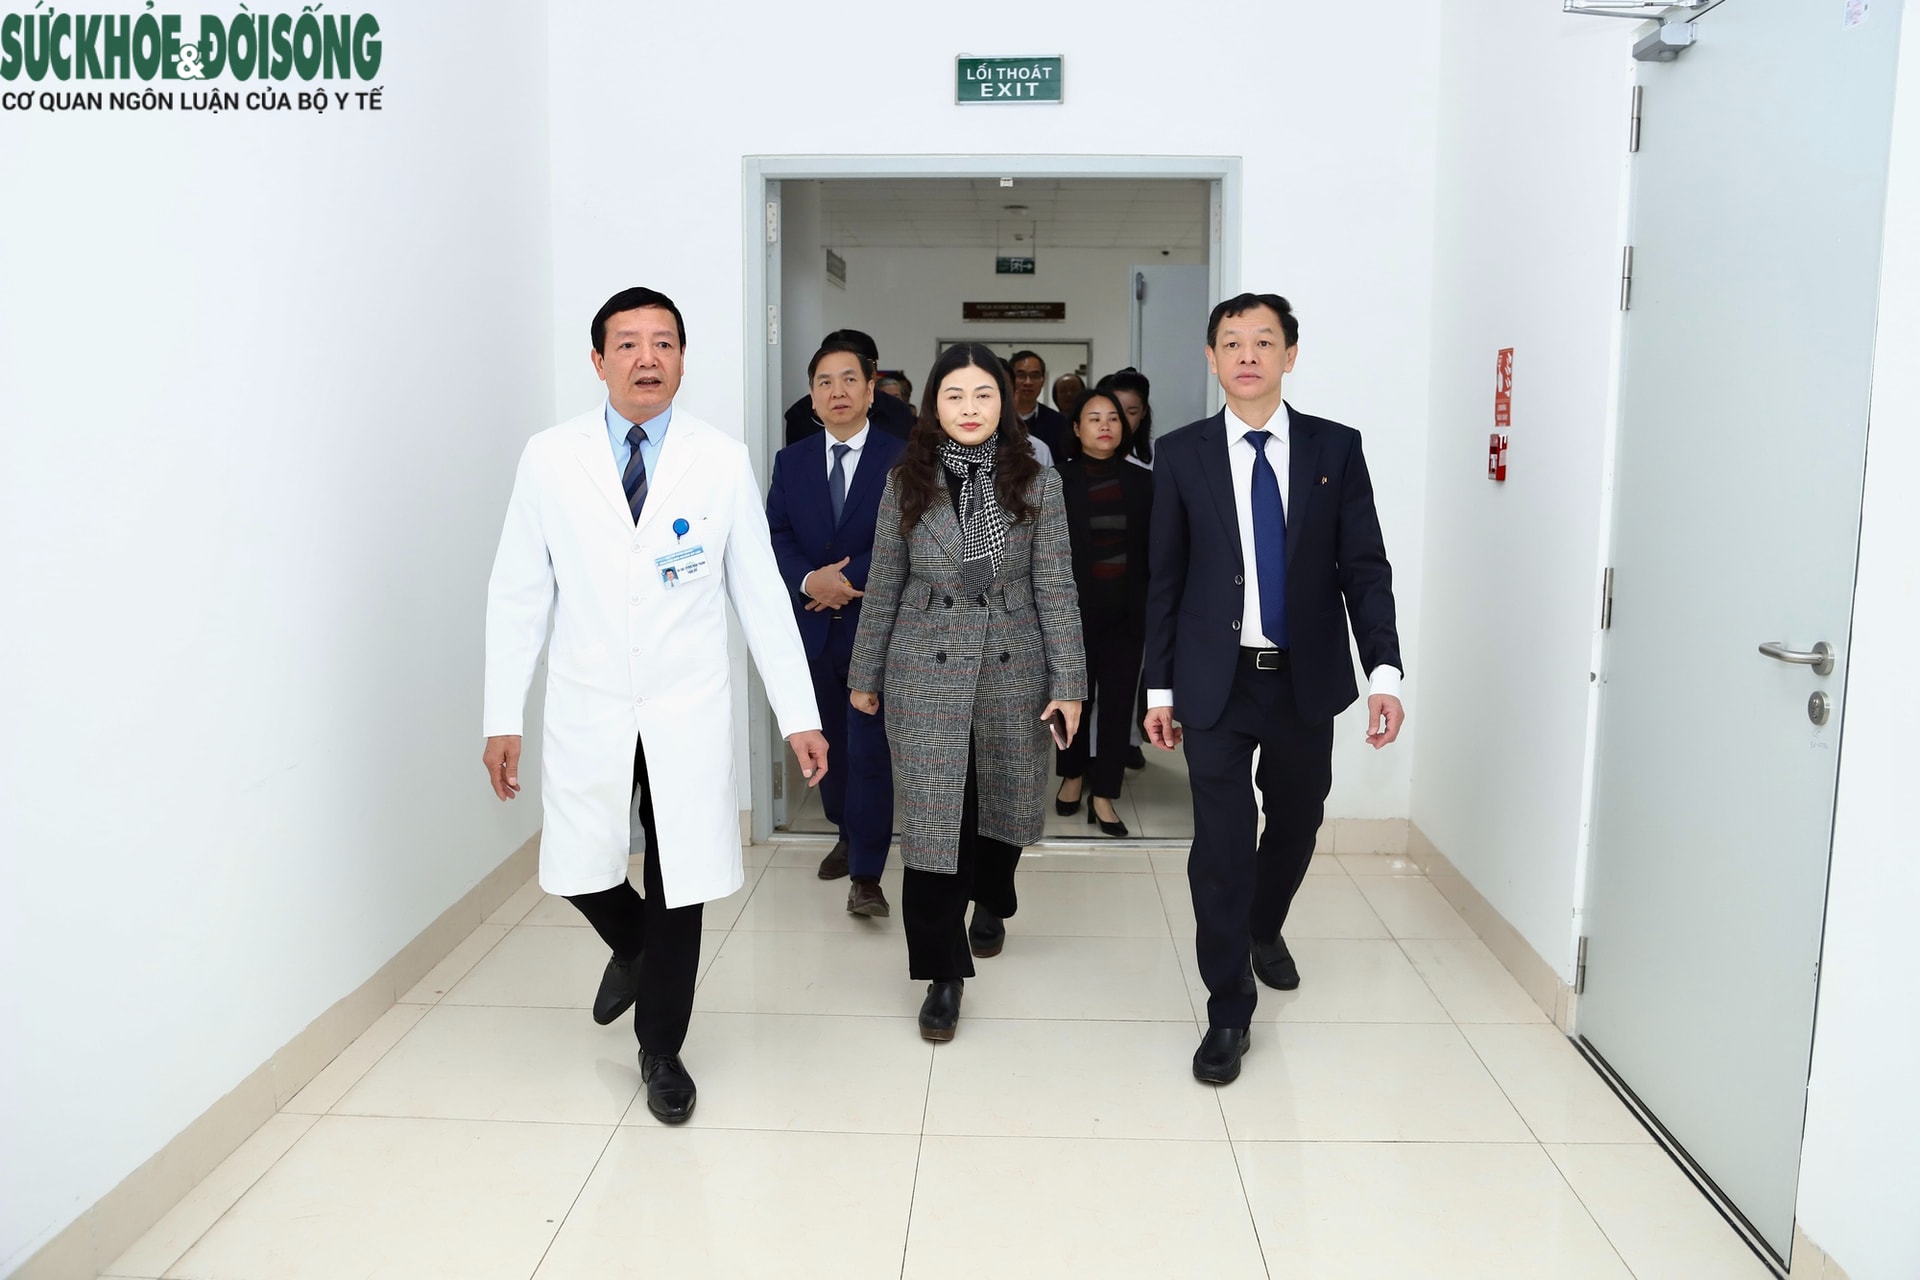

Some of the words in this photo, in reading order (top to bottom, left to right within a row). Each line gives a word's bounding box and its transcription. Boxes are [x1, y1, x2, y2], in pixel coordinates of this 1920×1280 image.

[968, 63, 992, 80] LỐI
[996, 65, 1052, 79] THOÁT
[981, 83, 1039, 97] EXIT
